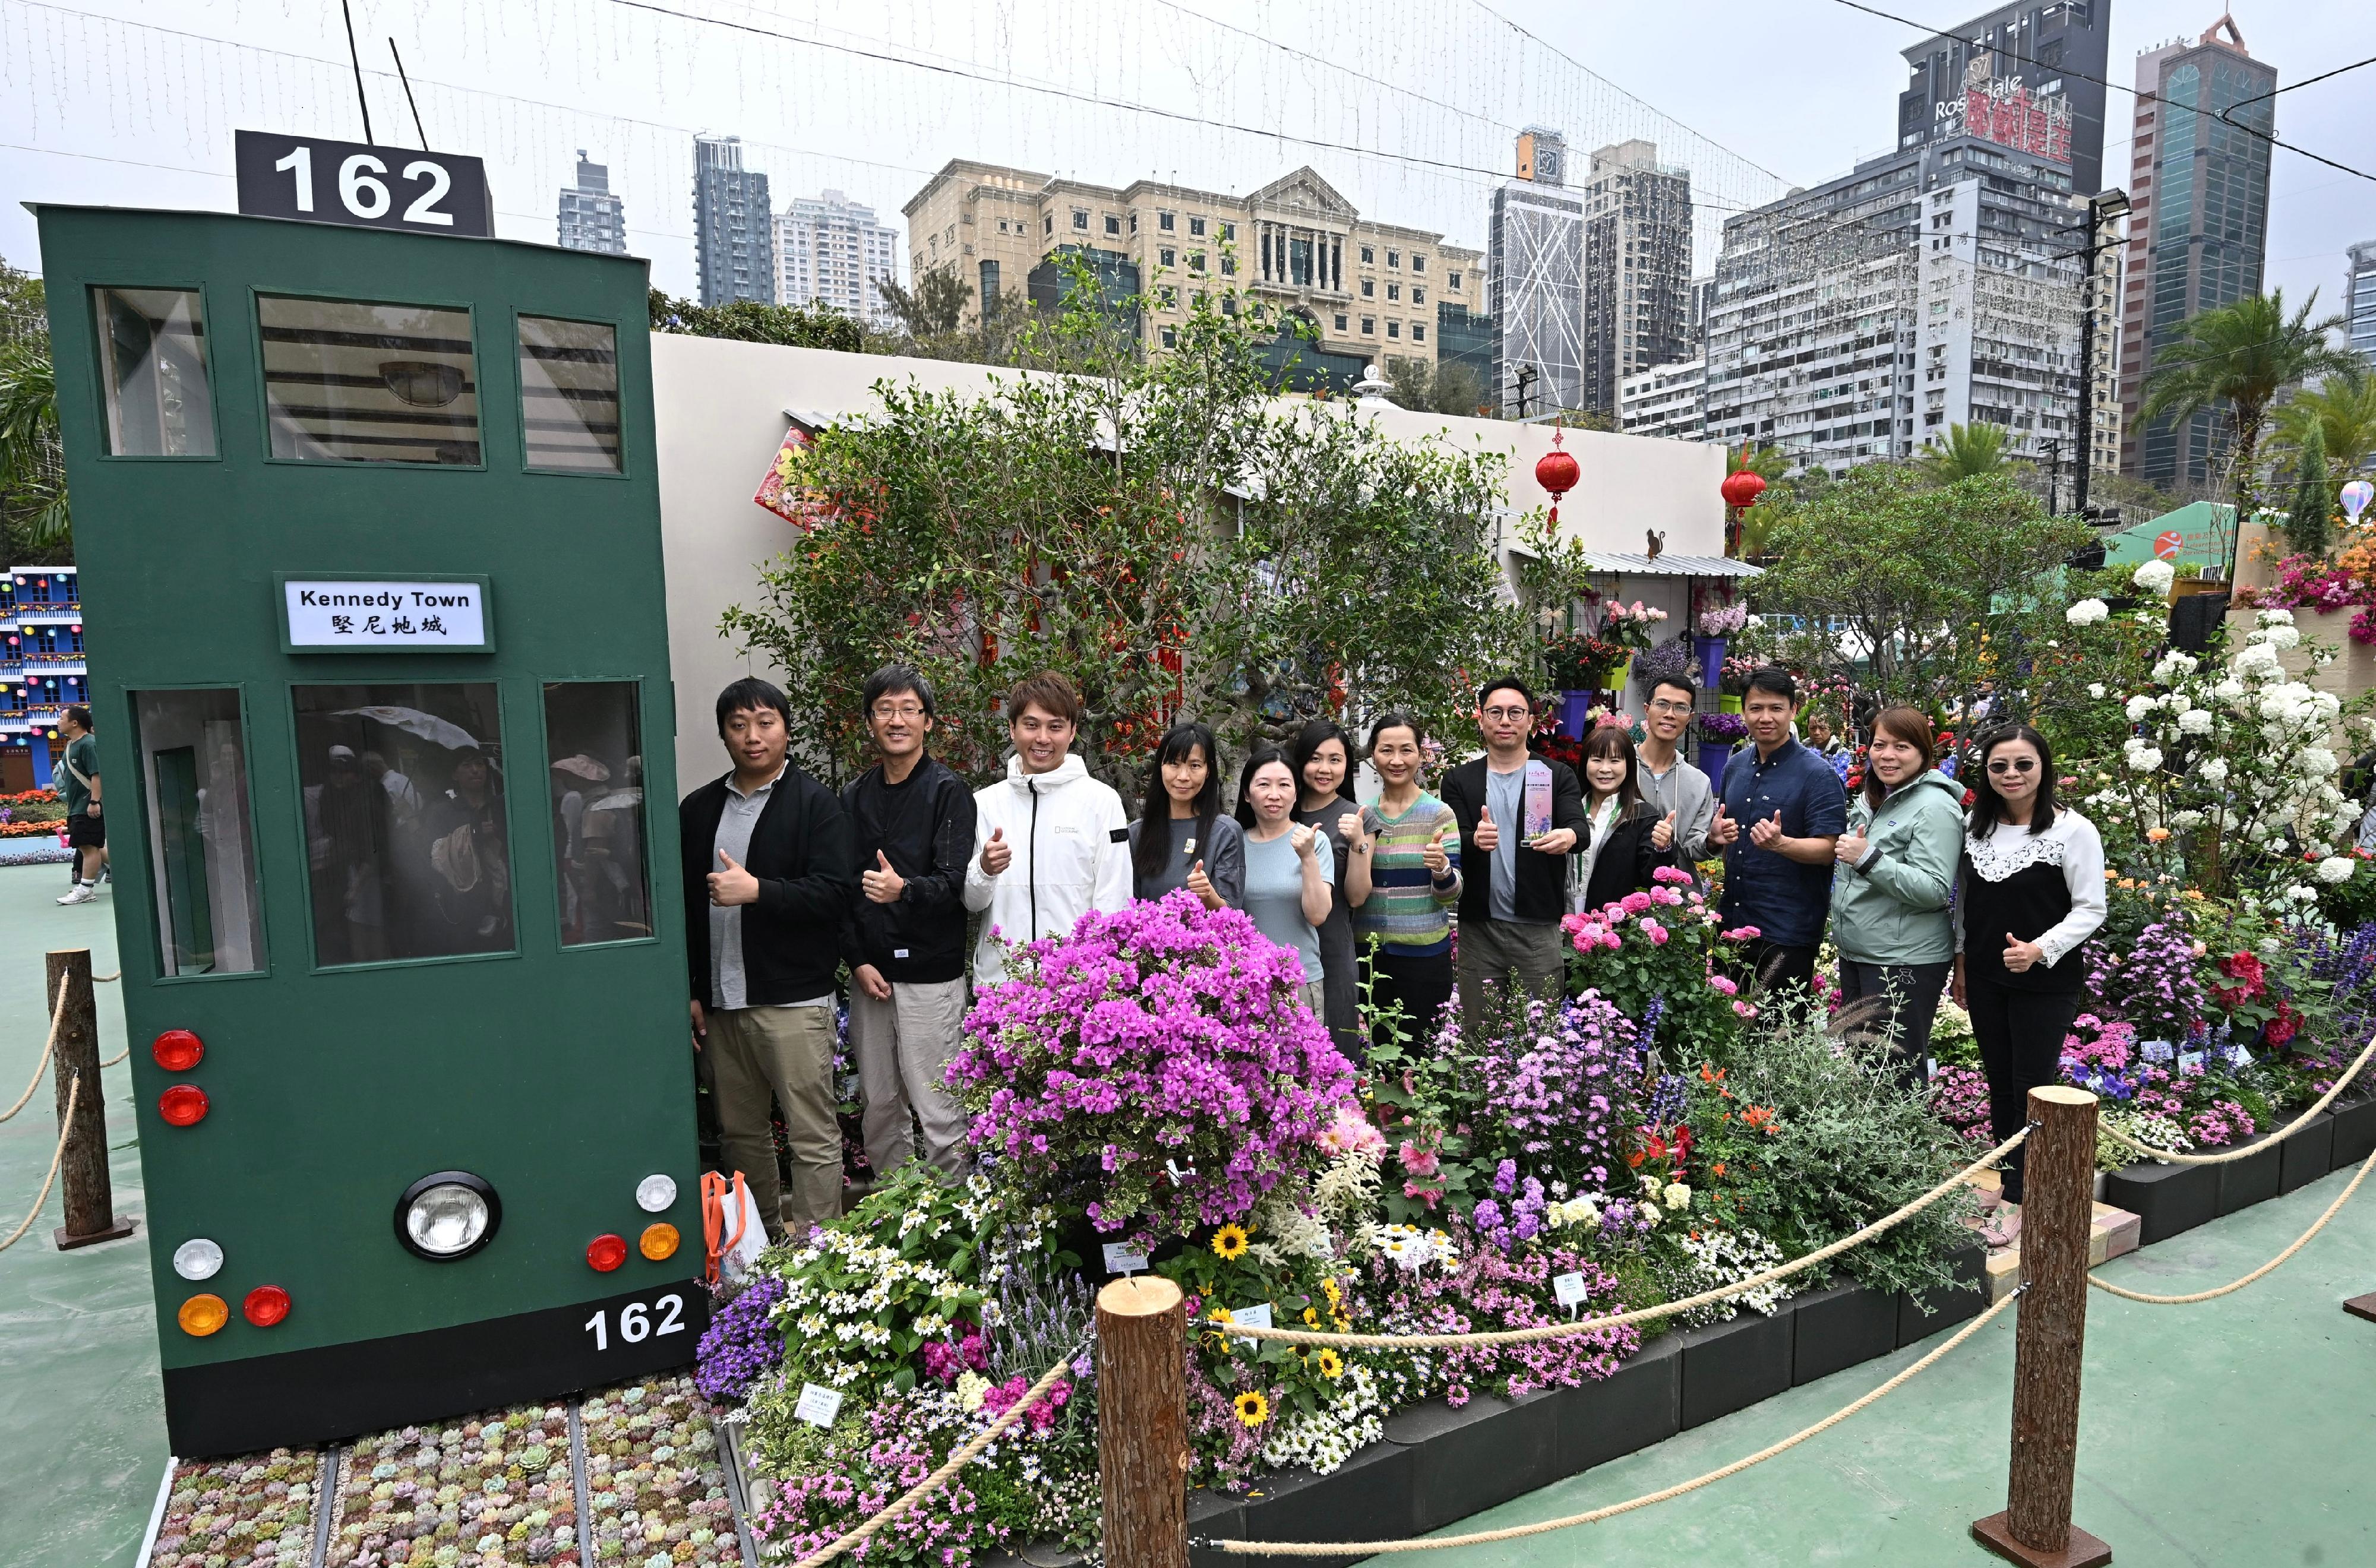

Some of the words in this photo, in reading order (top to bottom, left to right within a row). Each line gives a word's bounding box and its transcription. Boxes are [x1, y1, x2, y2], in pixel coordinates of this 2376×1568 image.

[1936, 75, 2023, 121] Rosdale
[276, 146, 453, 226] 162
[301, 590, 403, 610] Kennedy
[411, 592, 469, 607] Town
[331, 615, 447, 635] 堅尼地城
[585, 1294, 685, 1351] 162
